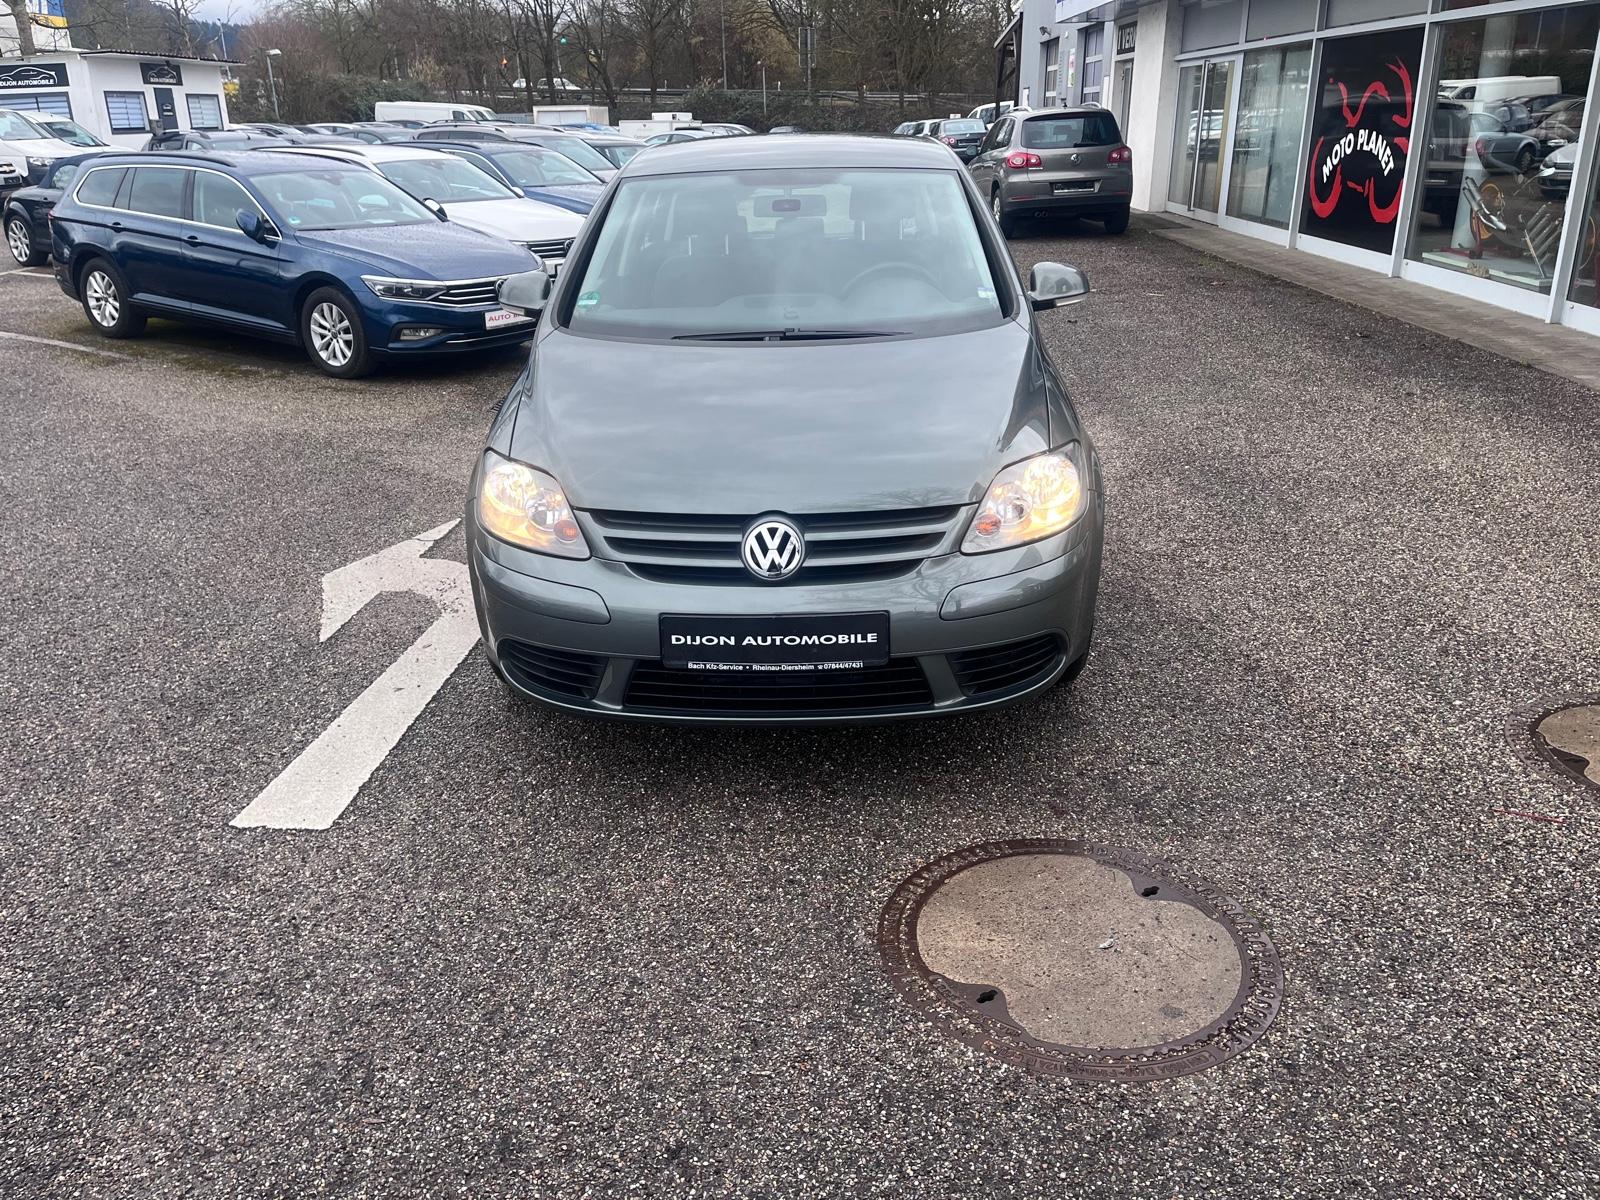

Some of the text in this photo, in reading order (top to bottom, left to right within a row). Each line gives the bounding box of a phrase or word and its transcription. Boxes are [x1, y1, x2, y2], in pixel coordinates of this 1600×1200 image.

[17, 78, 55, 86] AUTOMOBILE
[1322, 129, 1395, 184] MOTO PLANET
[488, 313, 511, 322] AUTO
[671, 632, 878, 646] DIJON AUTOMOBILE
[823, 662, 864, 670] 07844/47431
